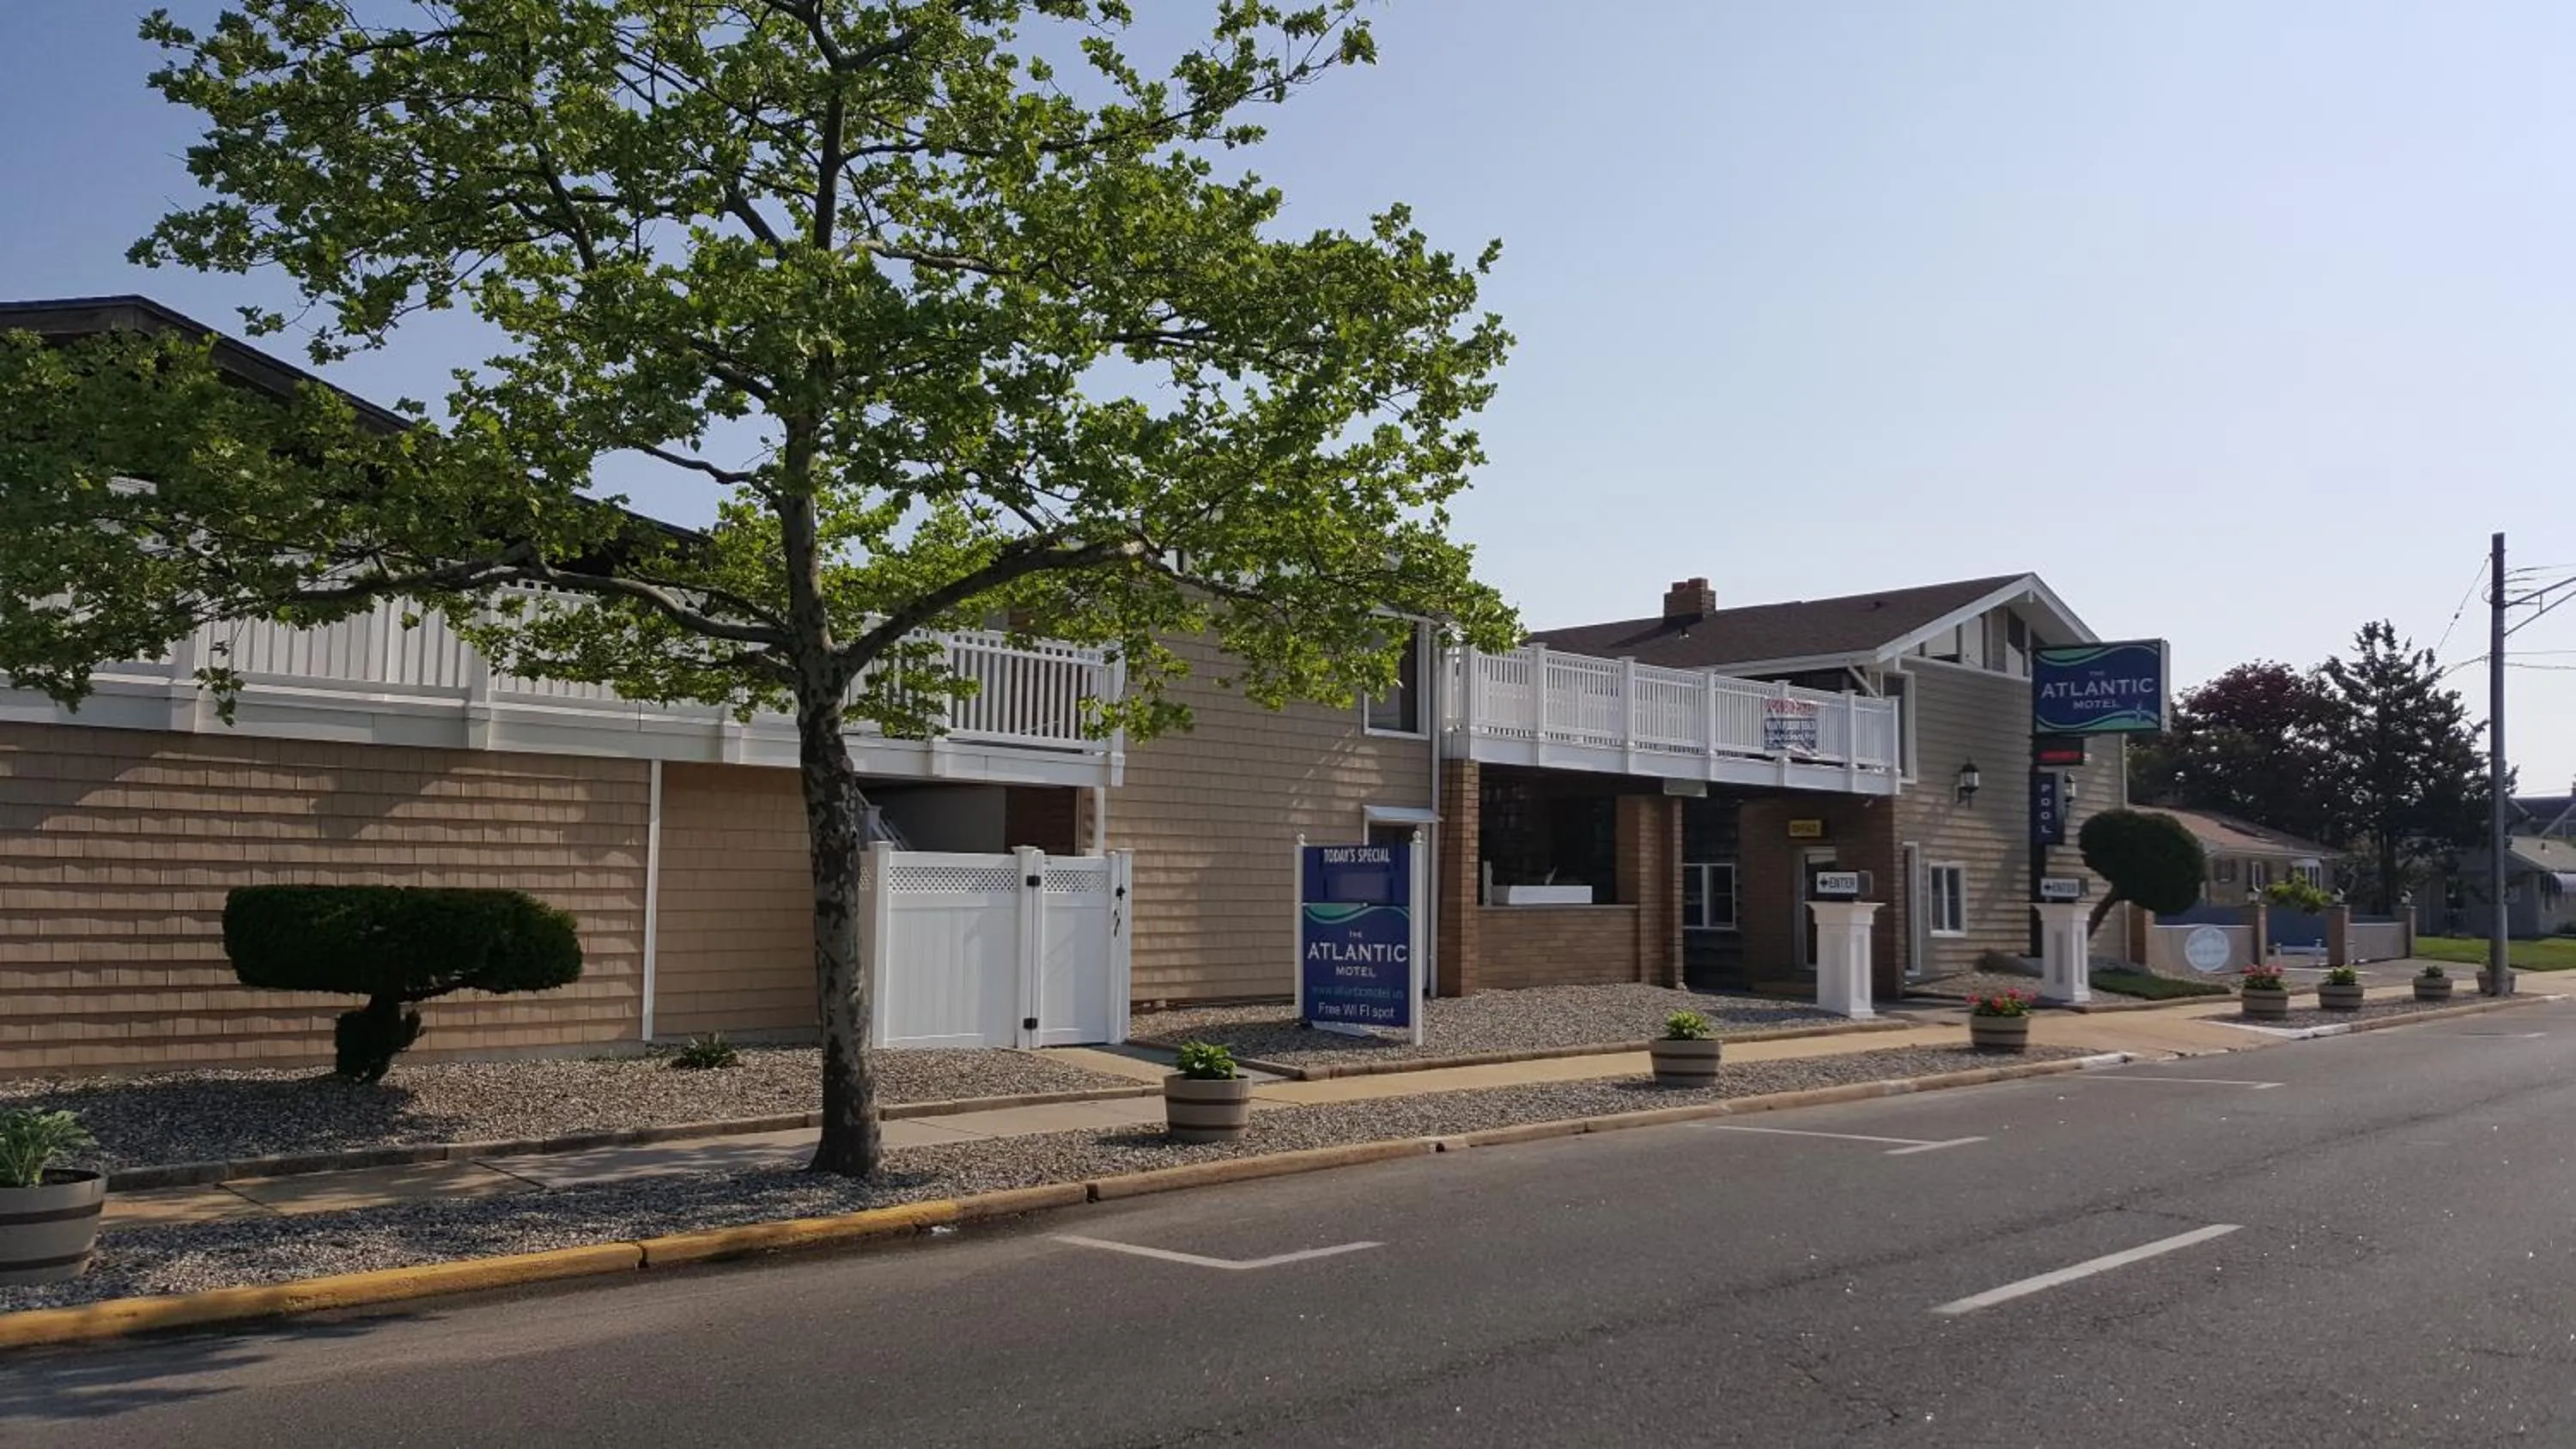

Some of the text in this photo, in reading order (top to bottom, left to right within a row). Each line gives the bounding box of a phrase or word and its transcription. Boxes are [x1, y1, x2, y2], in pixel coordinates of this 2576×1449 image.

[2040, 677, 2154, 699] ATLANTIC
[2073, 700, 2122, 709] MOTEL
[2040, 784, 2054, 834] POOL
[1323, 848, 1390, 863] TODAY'S SPECIAL
[1308, 943, 1407, 961] ATLANTIC
[1335, 966, 1376, 977] MOTEL
[1318, 1002, 1340, 1014] Free
[1372, 1007, 1395, 1019] spot
